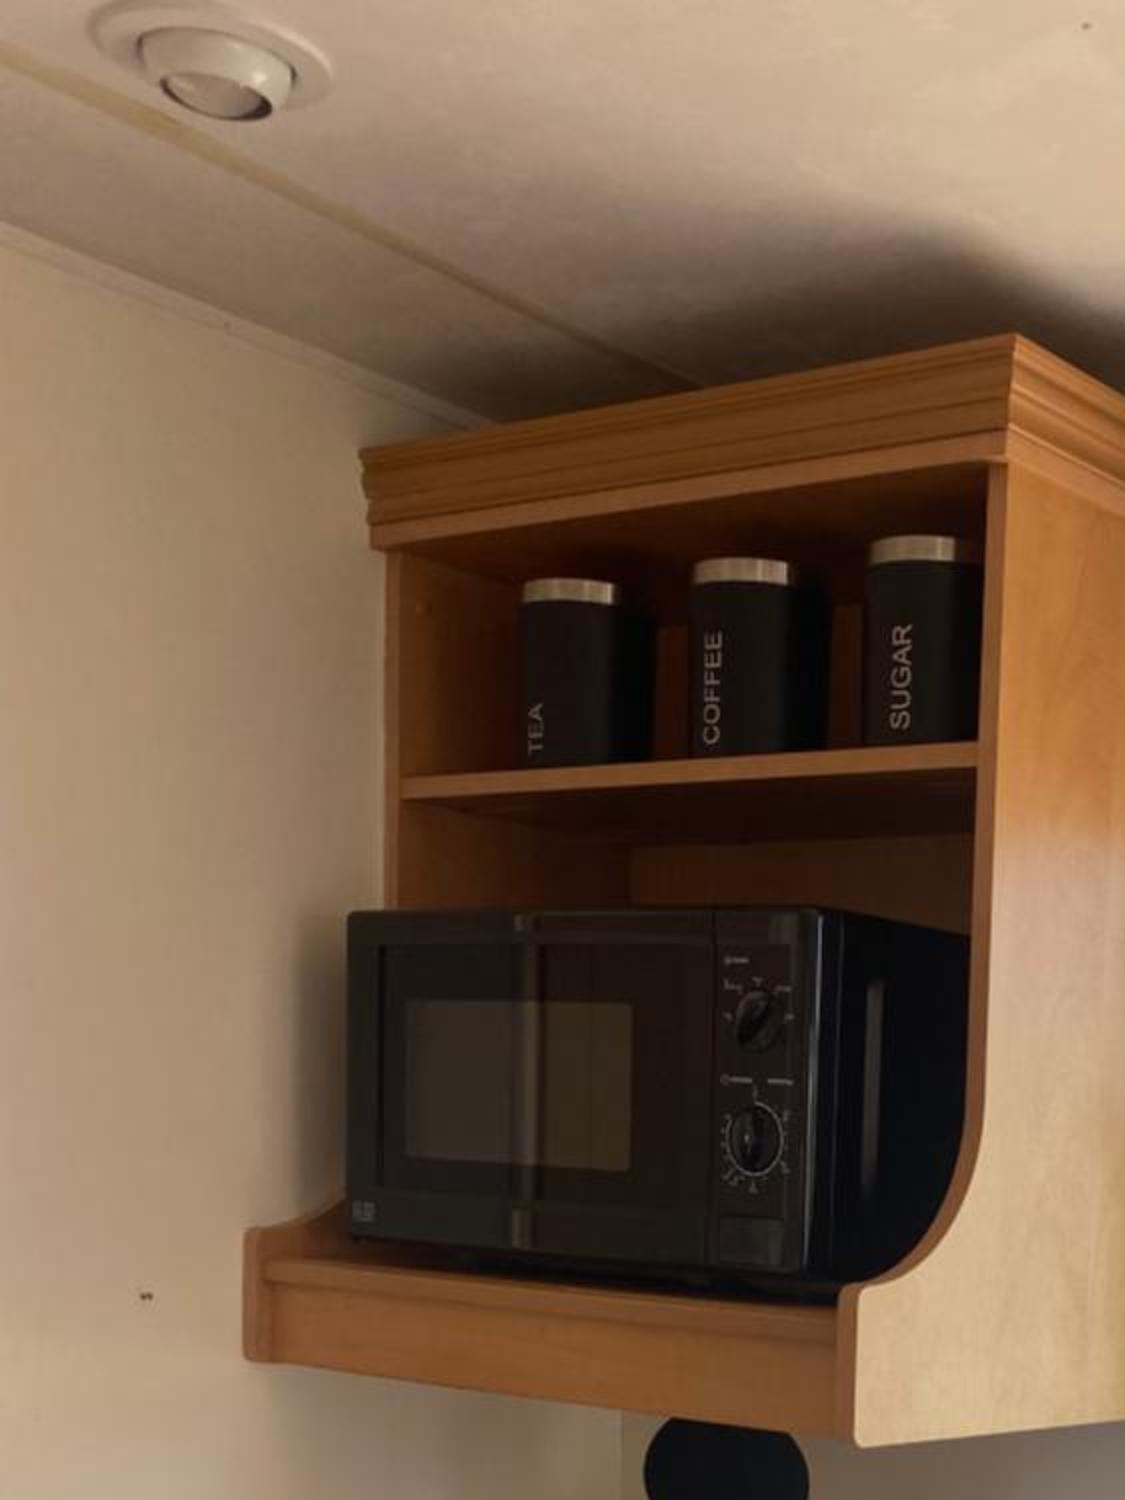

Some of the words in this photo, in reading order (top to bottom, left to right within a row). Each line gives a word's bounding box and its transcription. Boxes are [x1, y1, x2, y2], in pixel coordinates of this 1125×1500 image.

[527, 702, 545, 756] TEA
[702, 629, 724, 746] COFFEE
[889, 624, 913, 731] SUGAR
